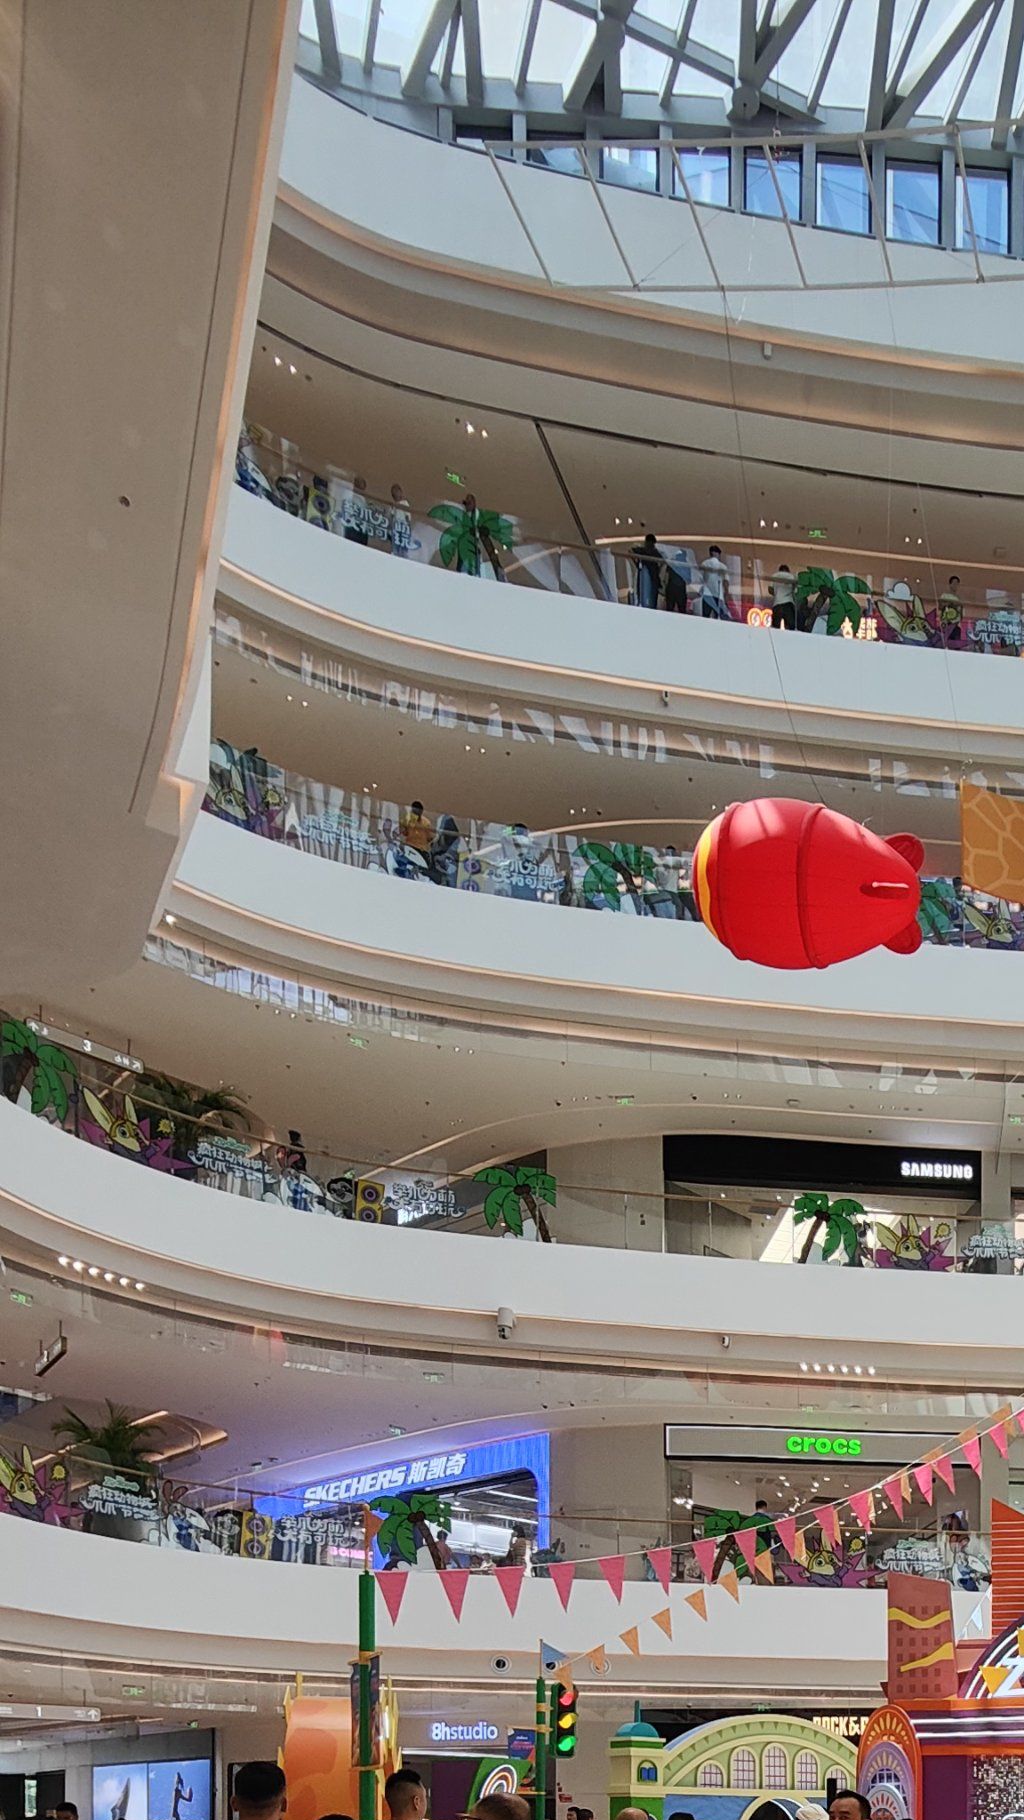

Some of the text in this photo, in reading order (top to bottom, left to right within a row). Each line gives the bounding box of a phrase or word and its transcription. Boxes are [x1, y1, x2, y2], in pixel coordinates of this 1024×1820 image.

[82, 1039, 92, 1051] 3
[901, 1161, 973, 1179] SAMSUNG
[787, 1436, 861, 1455] crocs
[303, 1452, 467, 1508] SKECHERS 斯凯奇
[431, 1721, 499, 1741] 8hstudio
